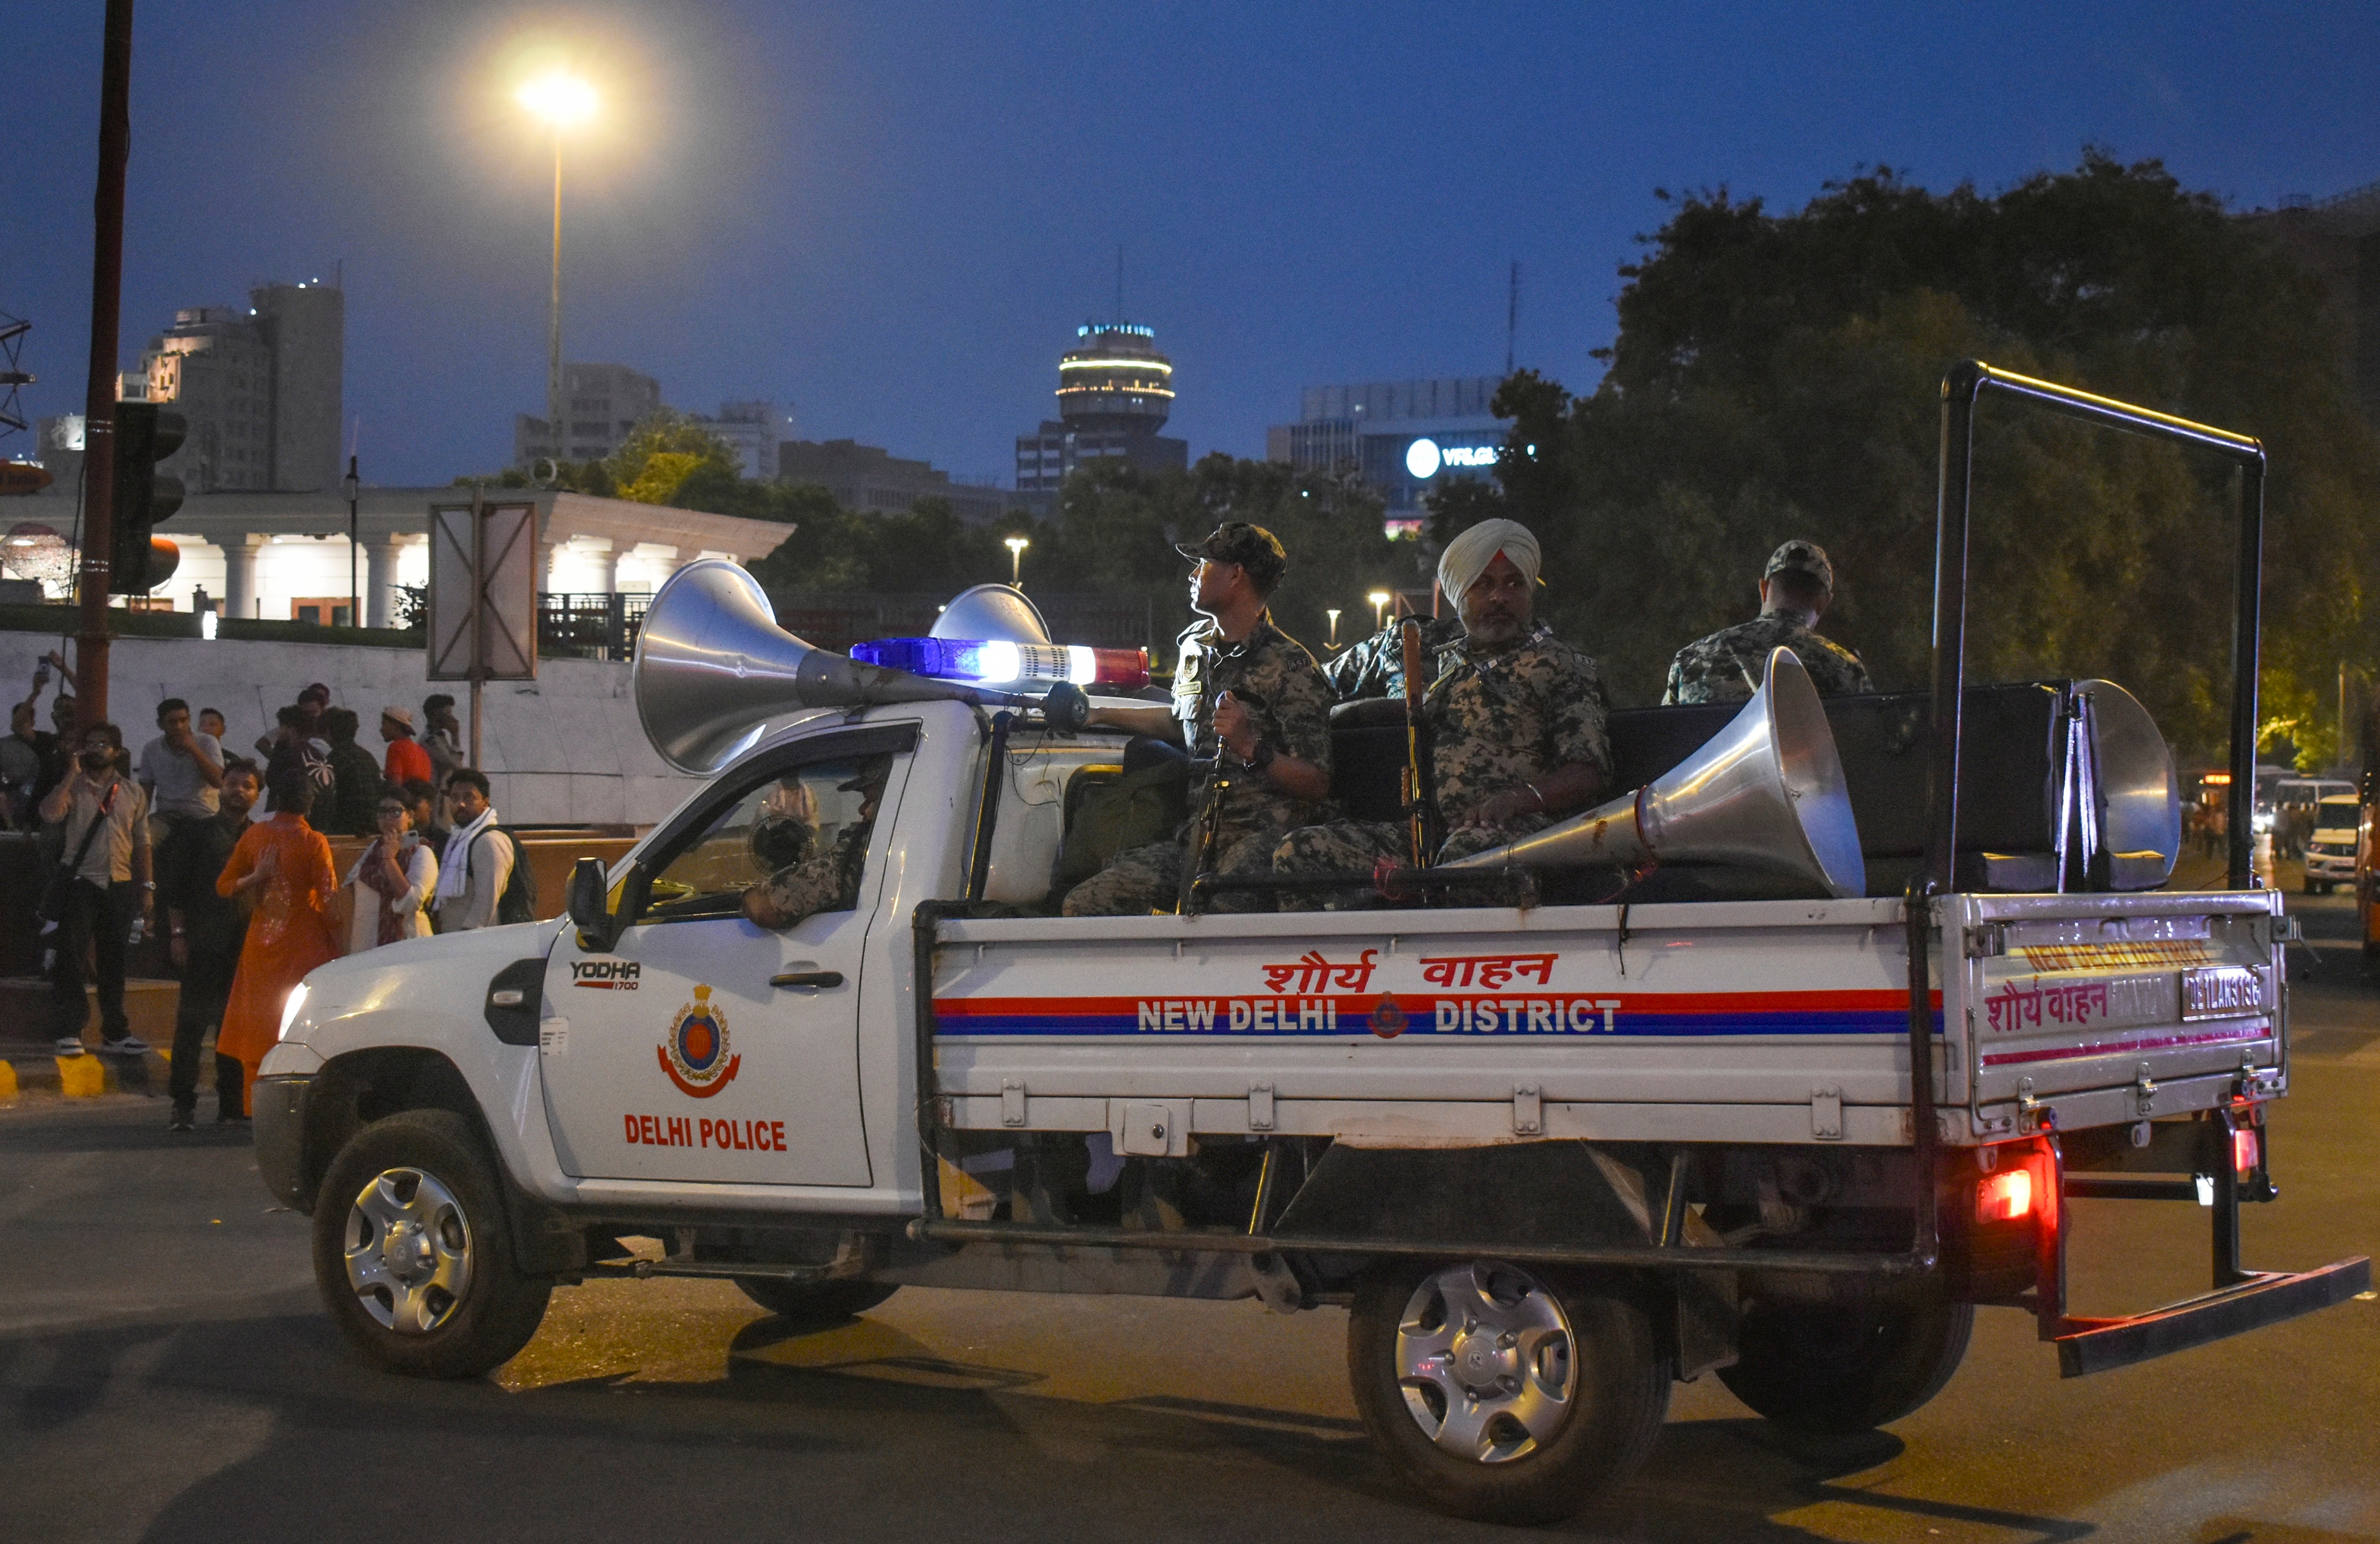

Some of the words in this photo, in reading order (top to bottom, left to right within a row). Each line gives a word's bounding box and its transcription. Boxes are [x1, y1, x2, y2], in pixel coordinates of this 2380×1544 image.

[571, 961, 640, 980] YODHA
[1262, 950, 1377, 995] शौर्य
[1420, 954, 1558, 989] वाहन
[2022, 944, 2073, 972] NEW
[2070, 942, 2129, 970] DELHI
[614, 981, 638, 990] 1700
[1138, 1000, 1216, 1031] NEW
[1229, 1000, 1336, 1031] DELHI
[1435, 999, 1621, 1032] DISTRICT
[2045, 984, 2107, 1024] वाहन
[625, 1115, 692, 1147] DELHI
[700, 1118, 787, 1151] POLICE
